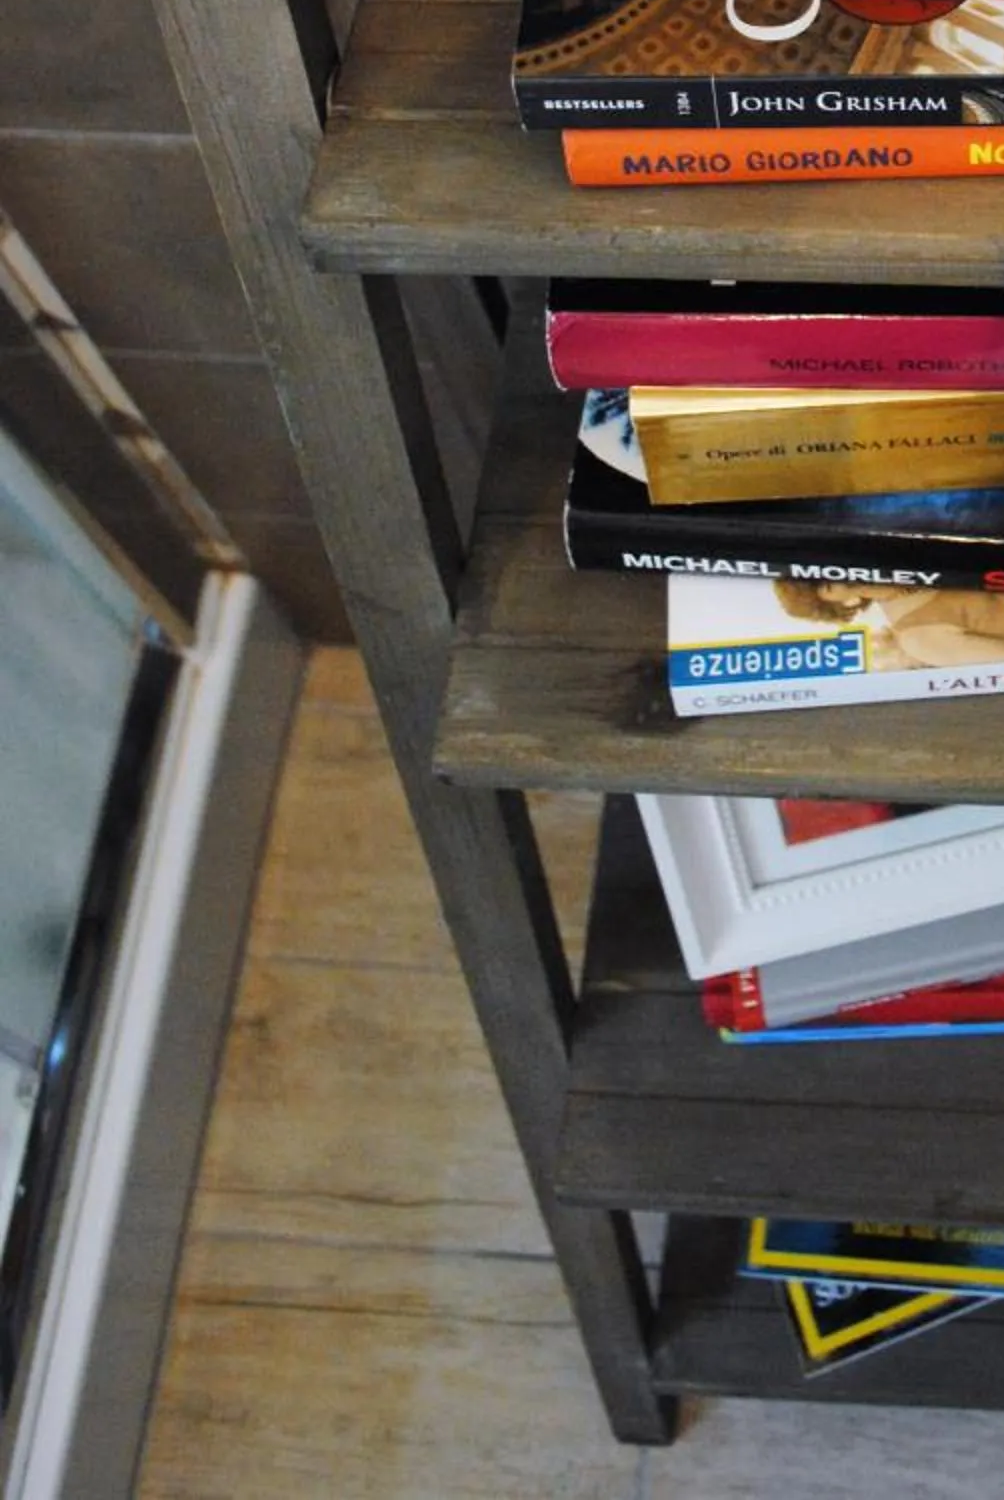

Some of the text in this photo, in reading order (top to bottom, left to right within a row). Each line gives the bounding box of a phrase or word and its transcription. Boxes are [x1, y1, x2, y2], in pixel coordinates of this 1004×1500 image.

[543, 99, 646, 111] BESTSELLERS
[622, 146, 914, 176] MARIO GIORDANO
[768, 358, 885, 373] MICHAEL
[705, 433, 977, 462] Opere di ORIANA FALLACI
[621, 552, 942, 586] MICHAEL MORLEY
[688, 633, 866, 680] Esperienze
[716, 689, 819, 707] SCHAEFER
